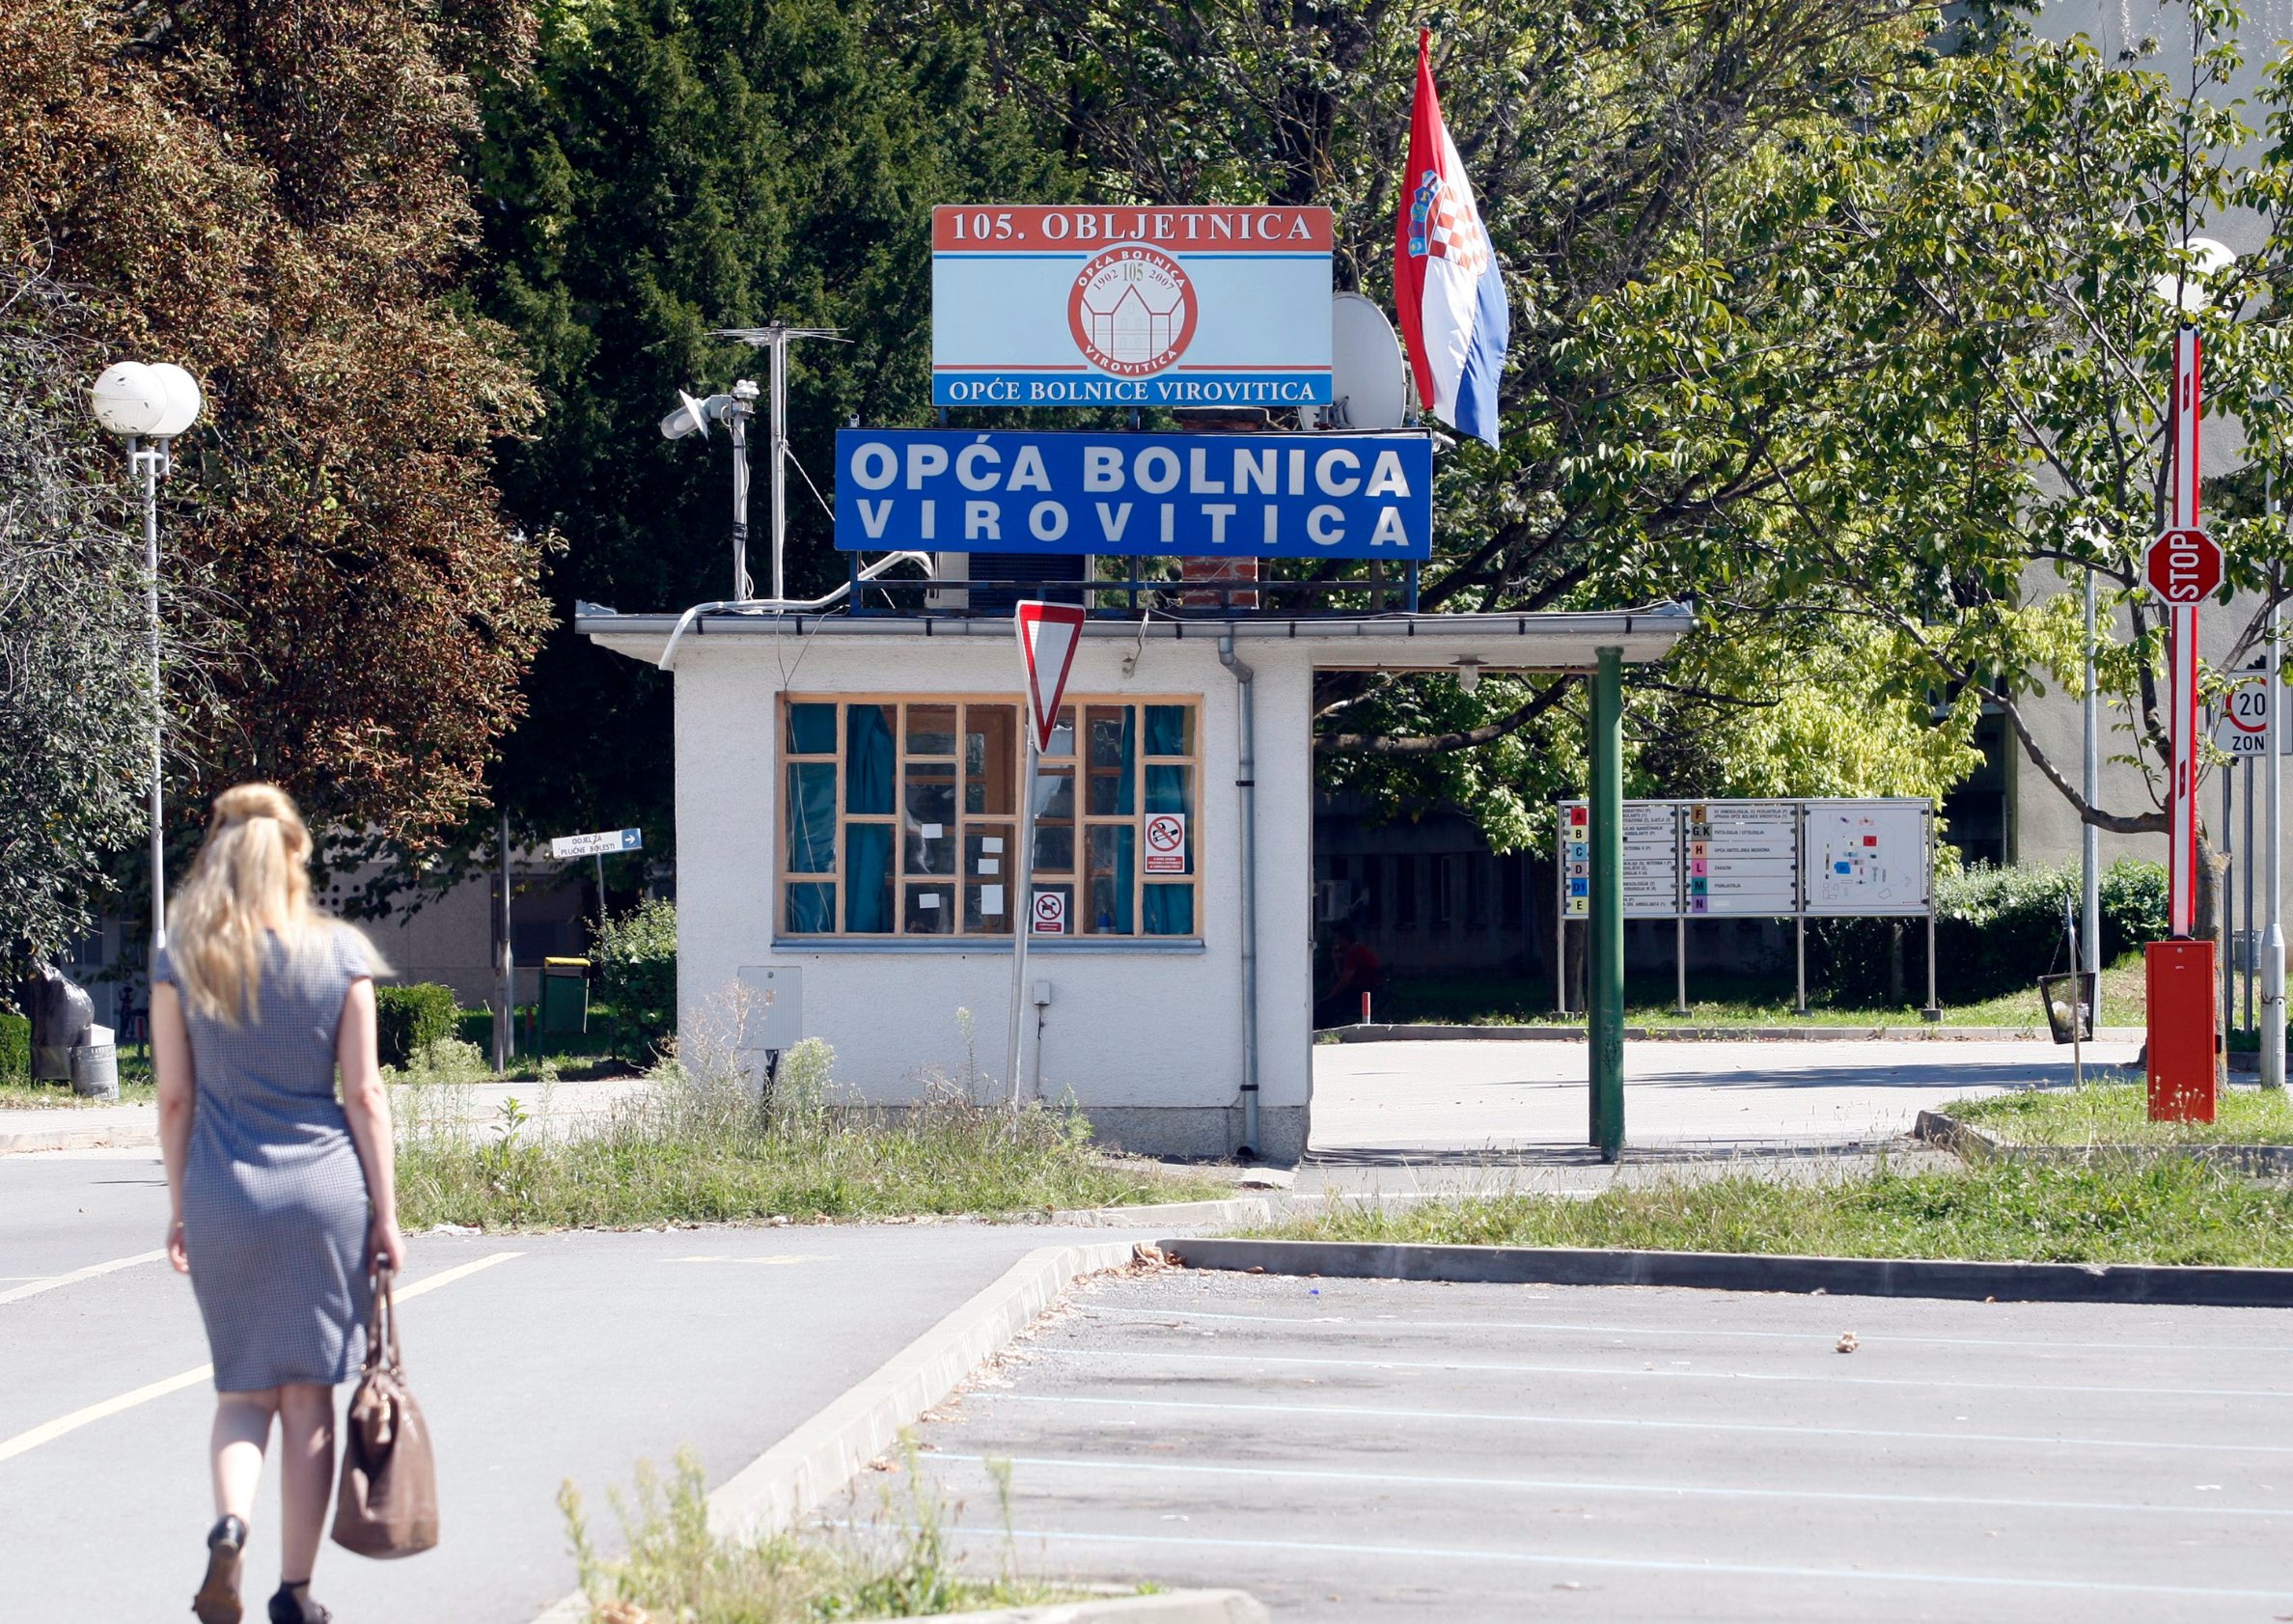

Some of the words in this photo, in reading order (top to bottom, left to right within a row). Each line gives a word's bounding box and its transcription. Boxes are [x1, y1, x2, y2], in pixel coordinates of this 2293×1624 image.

[953, 212, 1026, 240] 105.
[1041, 212, 1313, 241] OBLJETNICA
[1121, 250, 1185, 288] BOLNICA
[1123, 262, 1143, 281] 105
[1093, 269, 1119, 291] 1902
[1148, 270, 1175, 291] 2007
[1085, 344, 1177, 373] VIROVITICA
[949, 377, 1021, 401] OPĆE
[1029, 382, 1148, 401] BOLNICE
[1156, 381, 1316, 401] VIROVITICA
[850, 434, 1052, 493] OPĆA
[1084, 447, 1412, 498] BOLNICA
[857, 499, 1409, 547] VIROVITICA
[2169, 534, 2199, 600] STOP
[2239, 692, 2266, 716] 20
[2232, 736, 2265, 751] ZON
[1575, 812, 1583, 821] A
[1696, 811, 1702, 819] F
[1575, 829, 1582, 839] B
[590, 843, 615, 852] BOLESTI
[1575, 847, 1582, 857] C
[1696, 845, 1703, 855] H
[1575, 865, 1582, 874] D
[1696, 863, 1702, 873] L
[1573, 882, 1585, 892] D1
[1695, 881, 1704, 890] M
[1577, 901, 1583, 910] E
[1696, 899, 1703, 909] N
